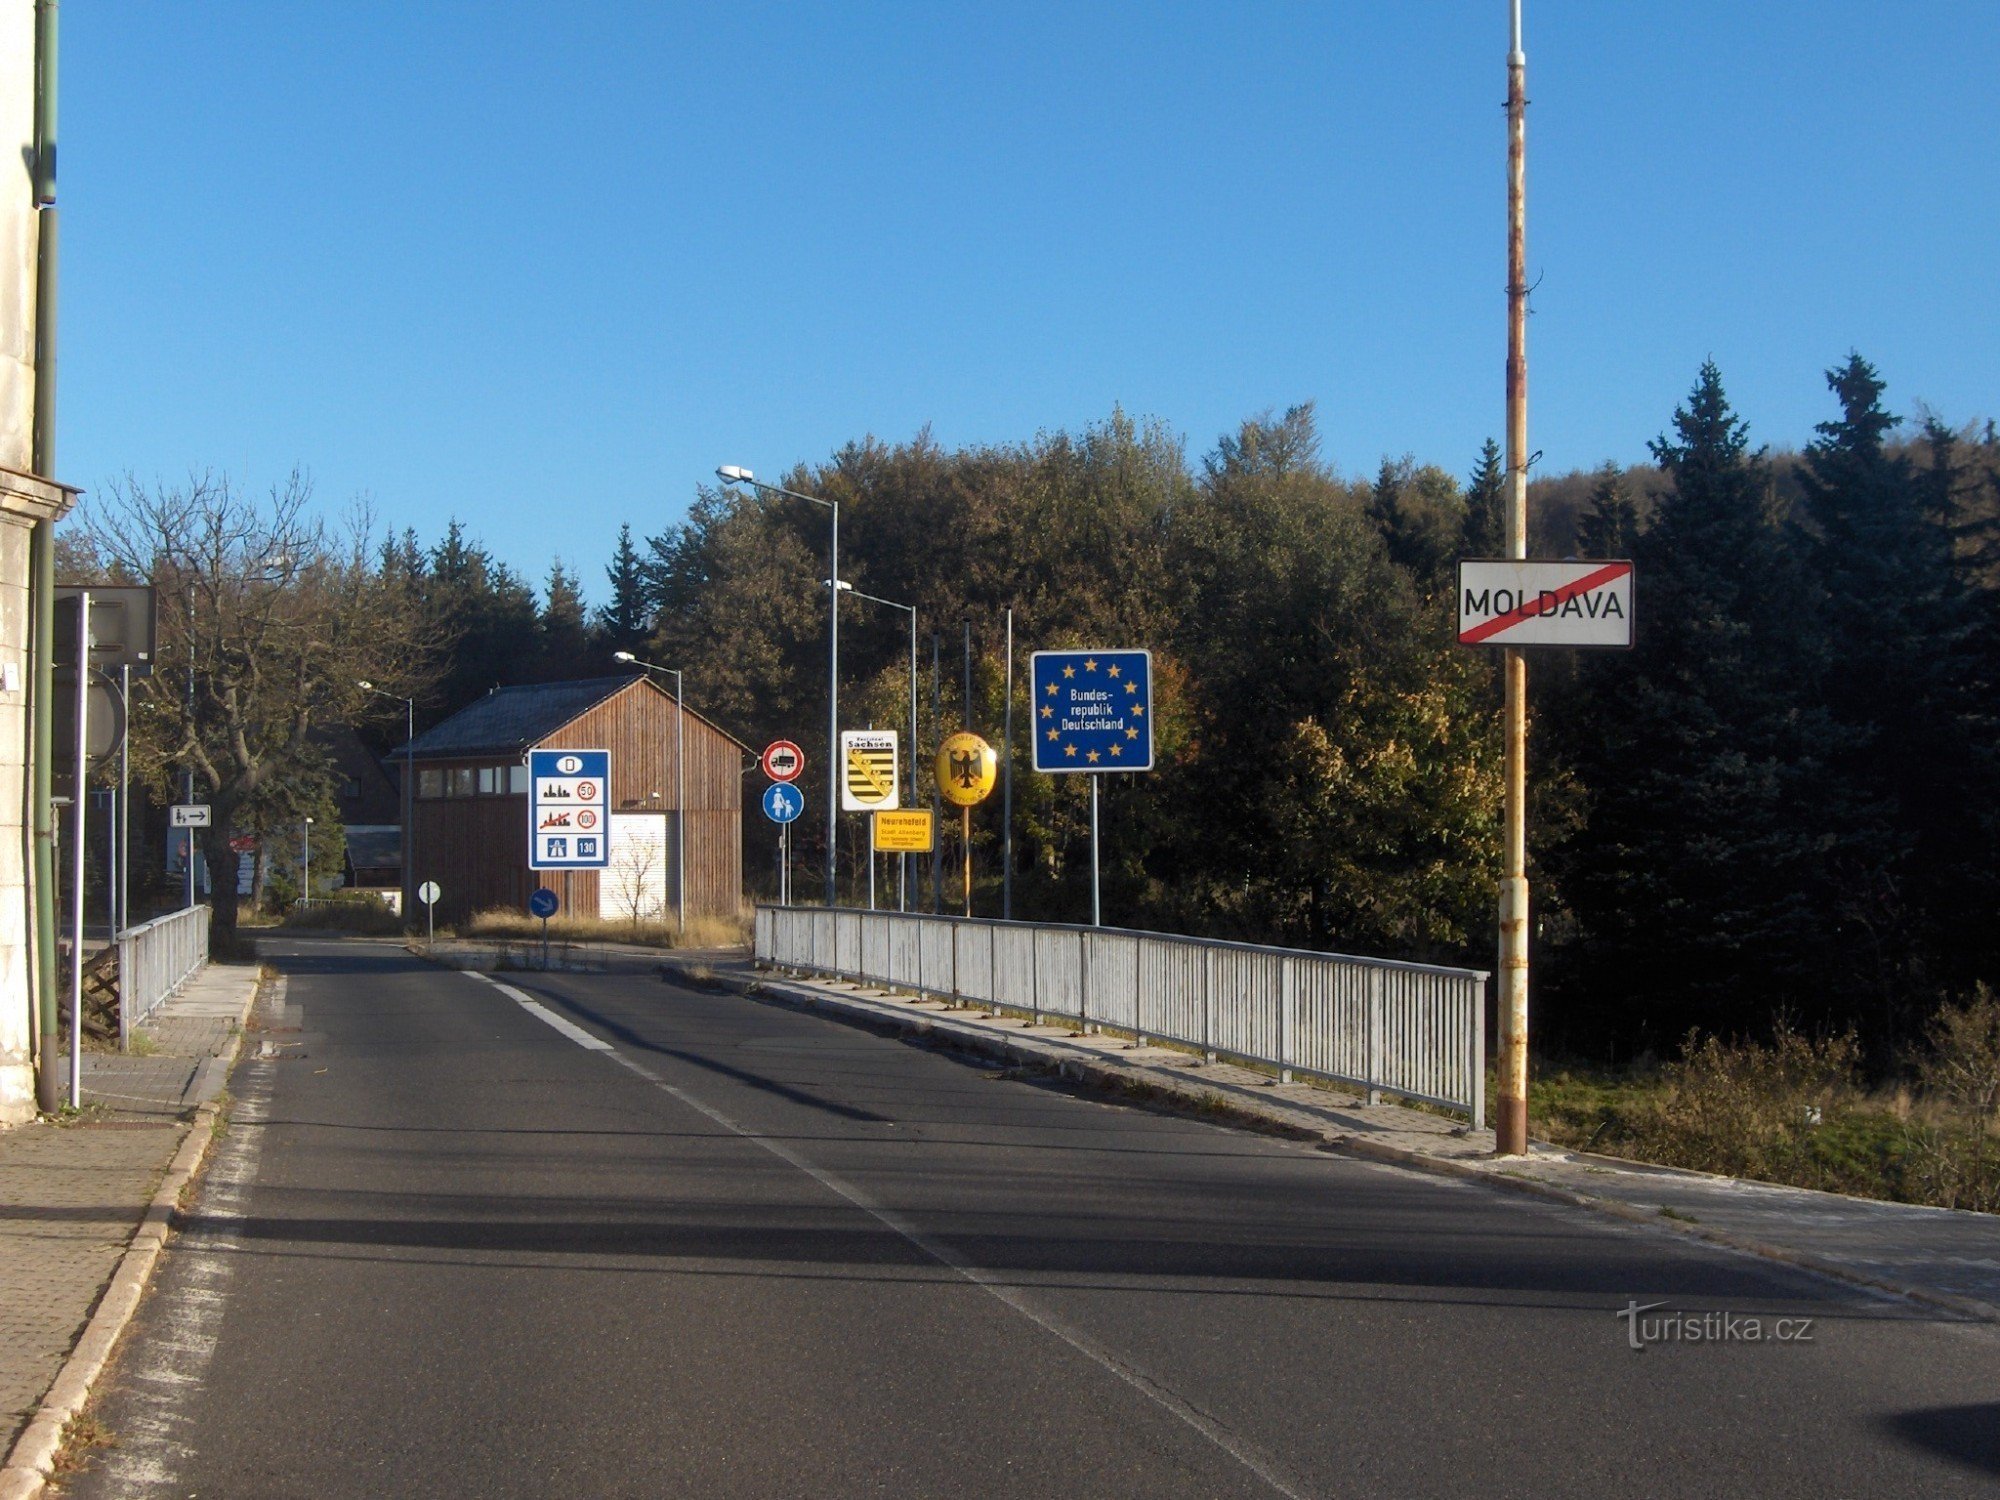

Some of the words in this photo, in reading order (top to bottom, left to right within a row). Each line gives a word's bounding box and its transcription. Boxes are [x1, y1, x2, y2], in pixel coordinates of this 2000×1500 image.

[1464, 588, 1625, 619] MOLDAVA
[1070, 688, 1114, 701] Bundes-
[1070, 703, 1113, 718] republik
[1061, 717, 1124, 731] Deutschland
[848, 740, 893, 748] Sachsen
[566, 759, 574, 771] D
[581, 787, 592, 795] 50
[581, 814, 593, 824] 100
[580, 843, 594, 853] 130
